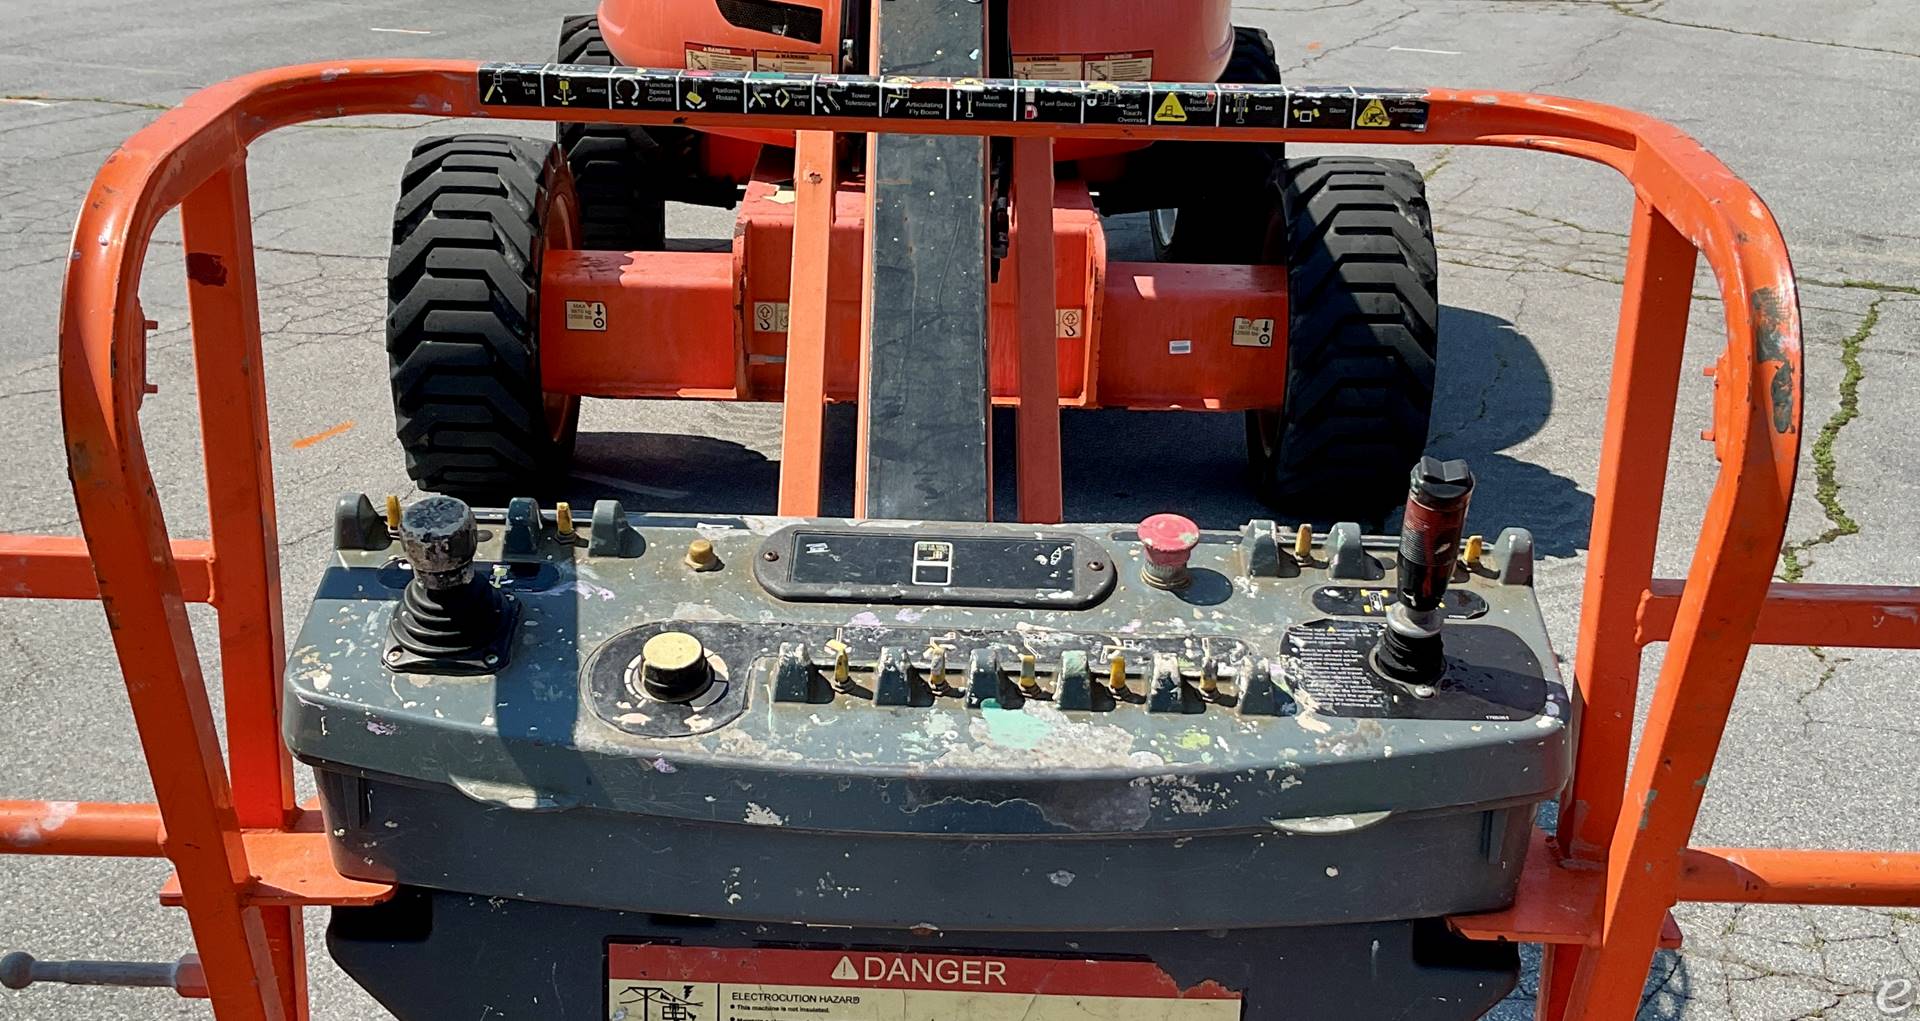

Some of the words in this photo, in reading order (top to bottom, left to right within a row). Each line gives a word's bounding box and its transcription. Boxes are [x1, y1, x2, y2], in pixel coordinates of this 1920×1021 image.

[586, 86, 607, 95] Swing
[845, 99, 878, 107] Telescope
[906, 101, 943, 109] Articulating
[975, 101, 1008, 109] Telescope
[1056, 100, 1077, 108] Select
[1389, 106, 1425, 114] Orientation
[1118, 116, 1147, 124] Override
[863, 955, 1008, 987] DANGER
[731, 991, 817, 1004] ELECTROCUTION
[819, 995, 860, 1005] HAZARD
[799, 1005, 830, 1013] insulated.
